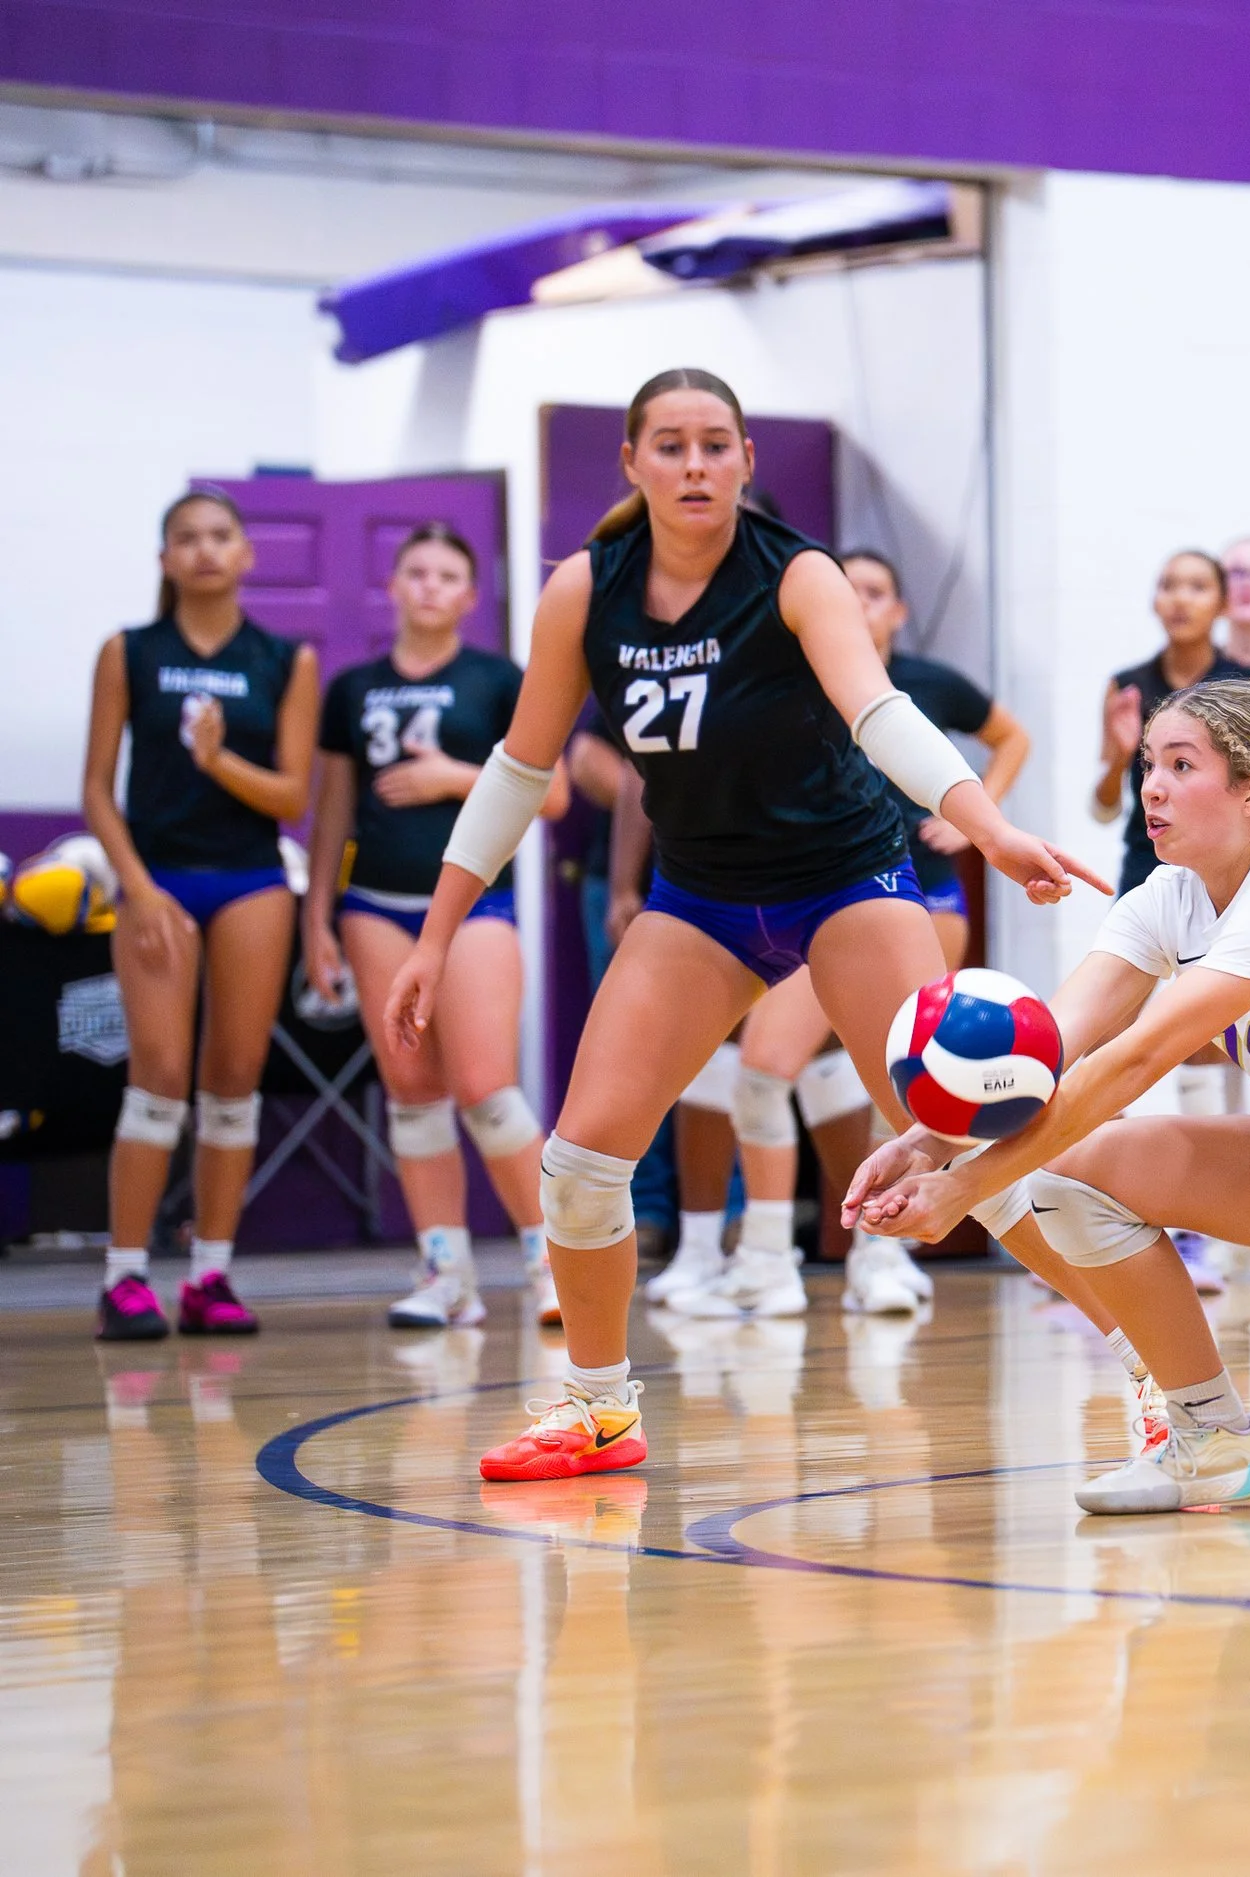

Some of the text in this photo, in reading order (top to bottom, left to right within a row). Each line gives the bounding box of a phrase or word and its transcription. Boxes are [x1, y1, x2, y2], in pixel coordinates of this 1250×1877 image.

[618, 637, 721, 671] VALENCIA
[360, 706, 442, 767] 34
[623, 673, 708, 753] 27
